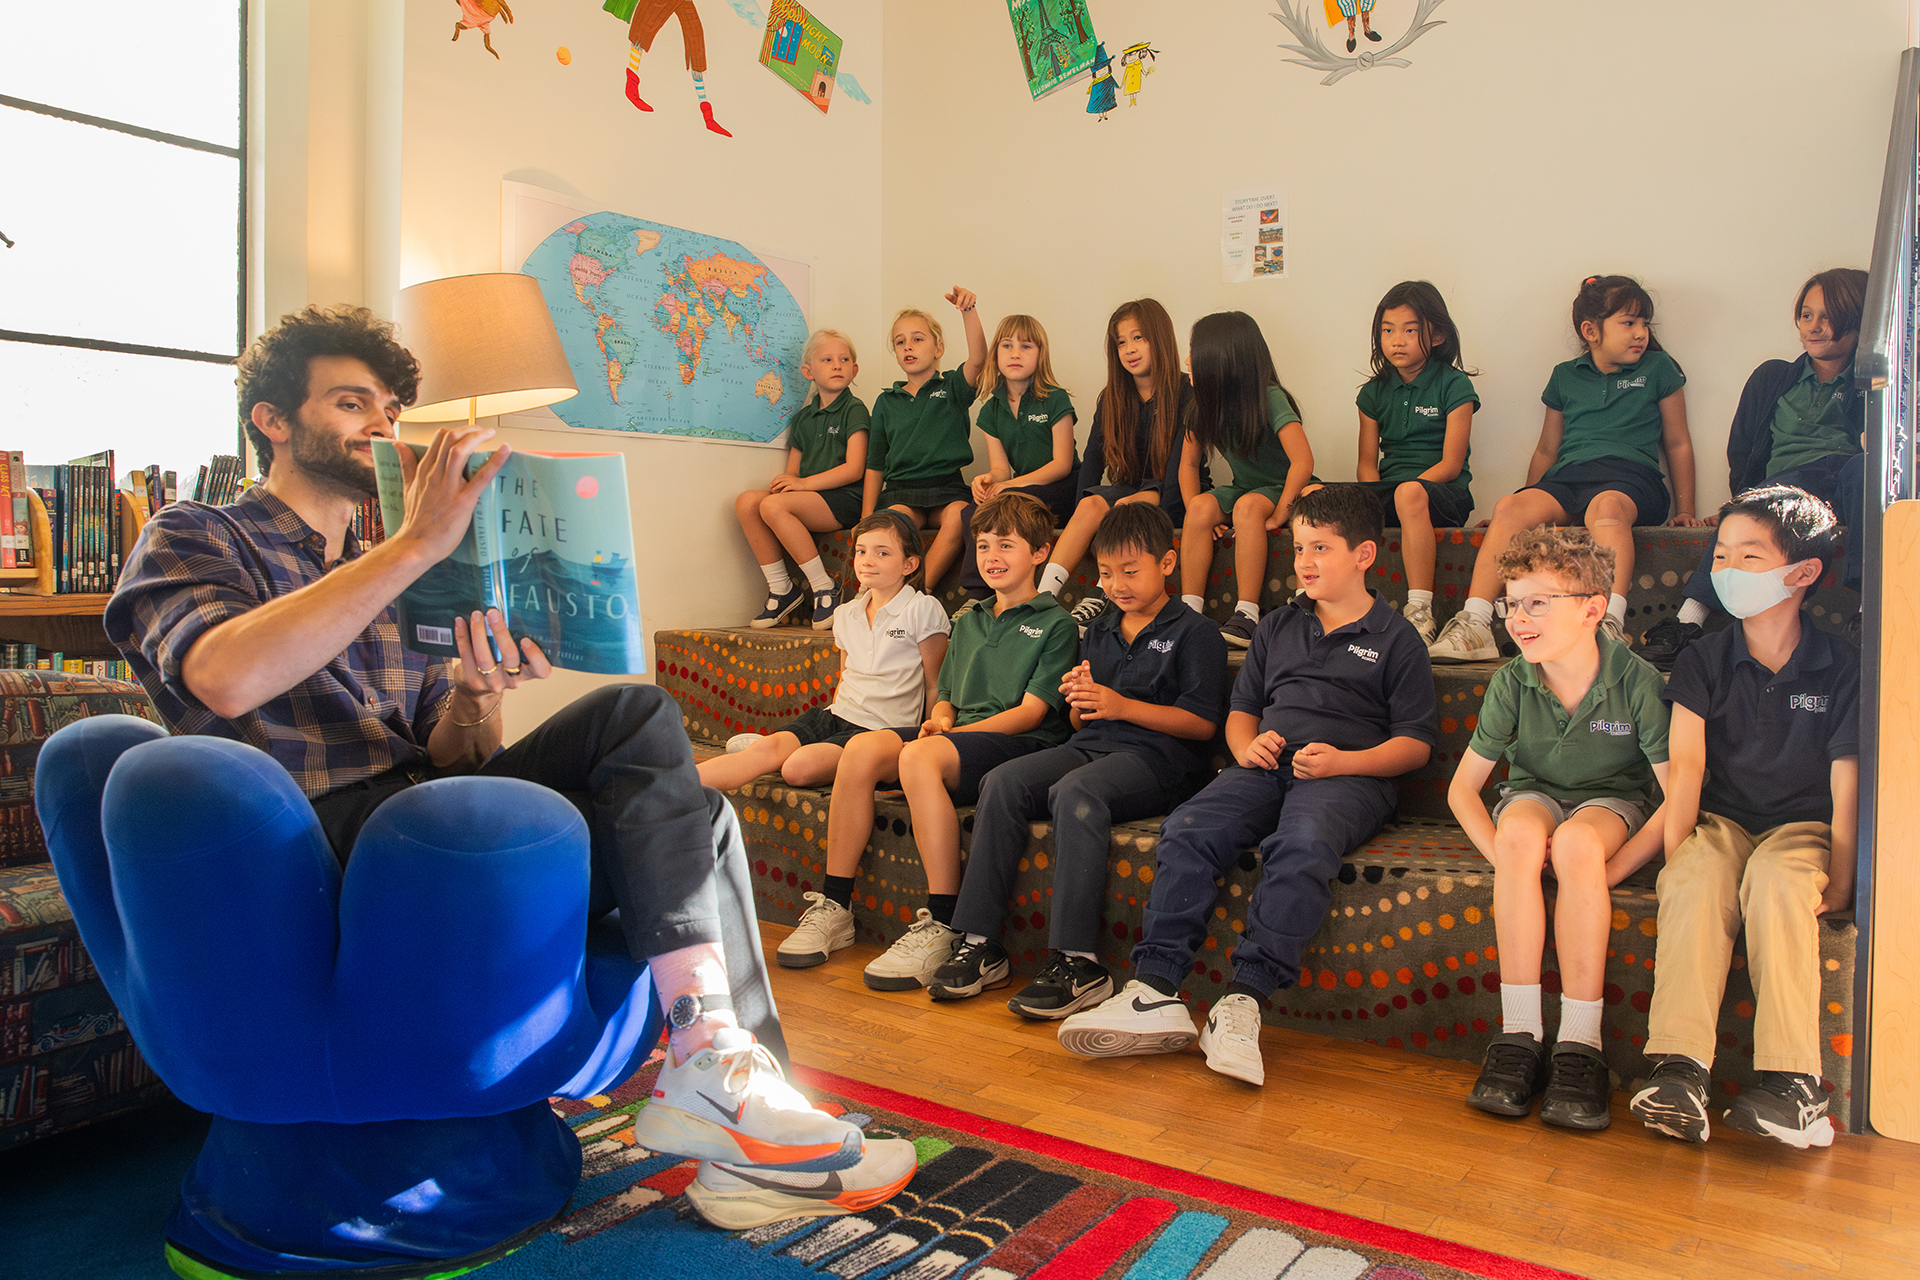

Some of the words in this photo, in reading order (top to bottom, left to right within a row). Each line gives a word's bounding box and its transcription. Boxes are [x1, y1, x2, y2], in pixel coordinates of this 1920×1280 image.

[774, 0, 829, 44] GOODNIGHT
[801, 38, 830, 64] MOON
[1032, 78, 1058, 96] LUDWIG
[708, 267, 738, 275] RUSSIA
[622, 275, 654, 285] ATLANTIC
[550, 306, 573, 314] CIFIC
[1028, 414, 1048, 423] Pilgrim
[1415, 406, 1438, 415] Pilgrim
[499, 475, 538, 498] THE
[502, 509, 568, 543] FATE
[478, 526, 487, 557] FAUSTO
[512, 547, 540, 573] of
[509, 583, 628, 619] FAUSTO
[1019, 624, 1043, 636] Pilgrim
[1348, 644, 1379, 659] Pilgrim
[1590, 719, 1632, 733] Pilgrim
